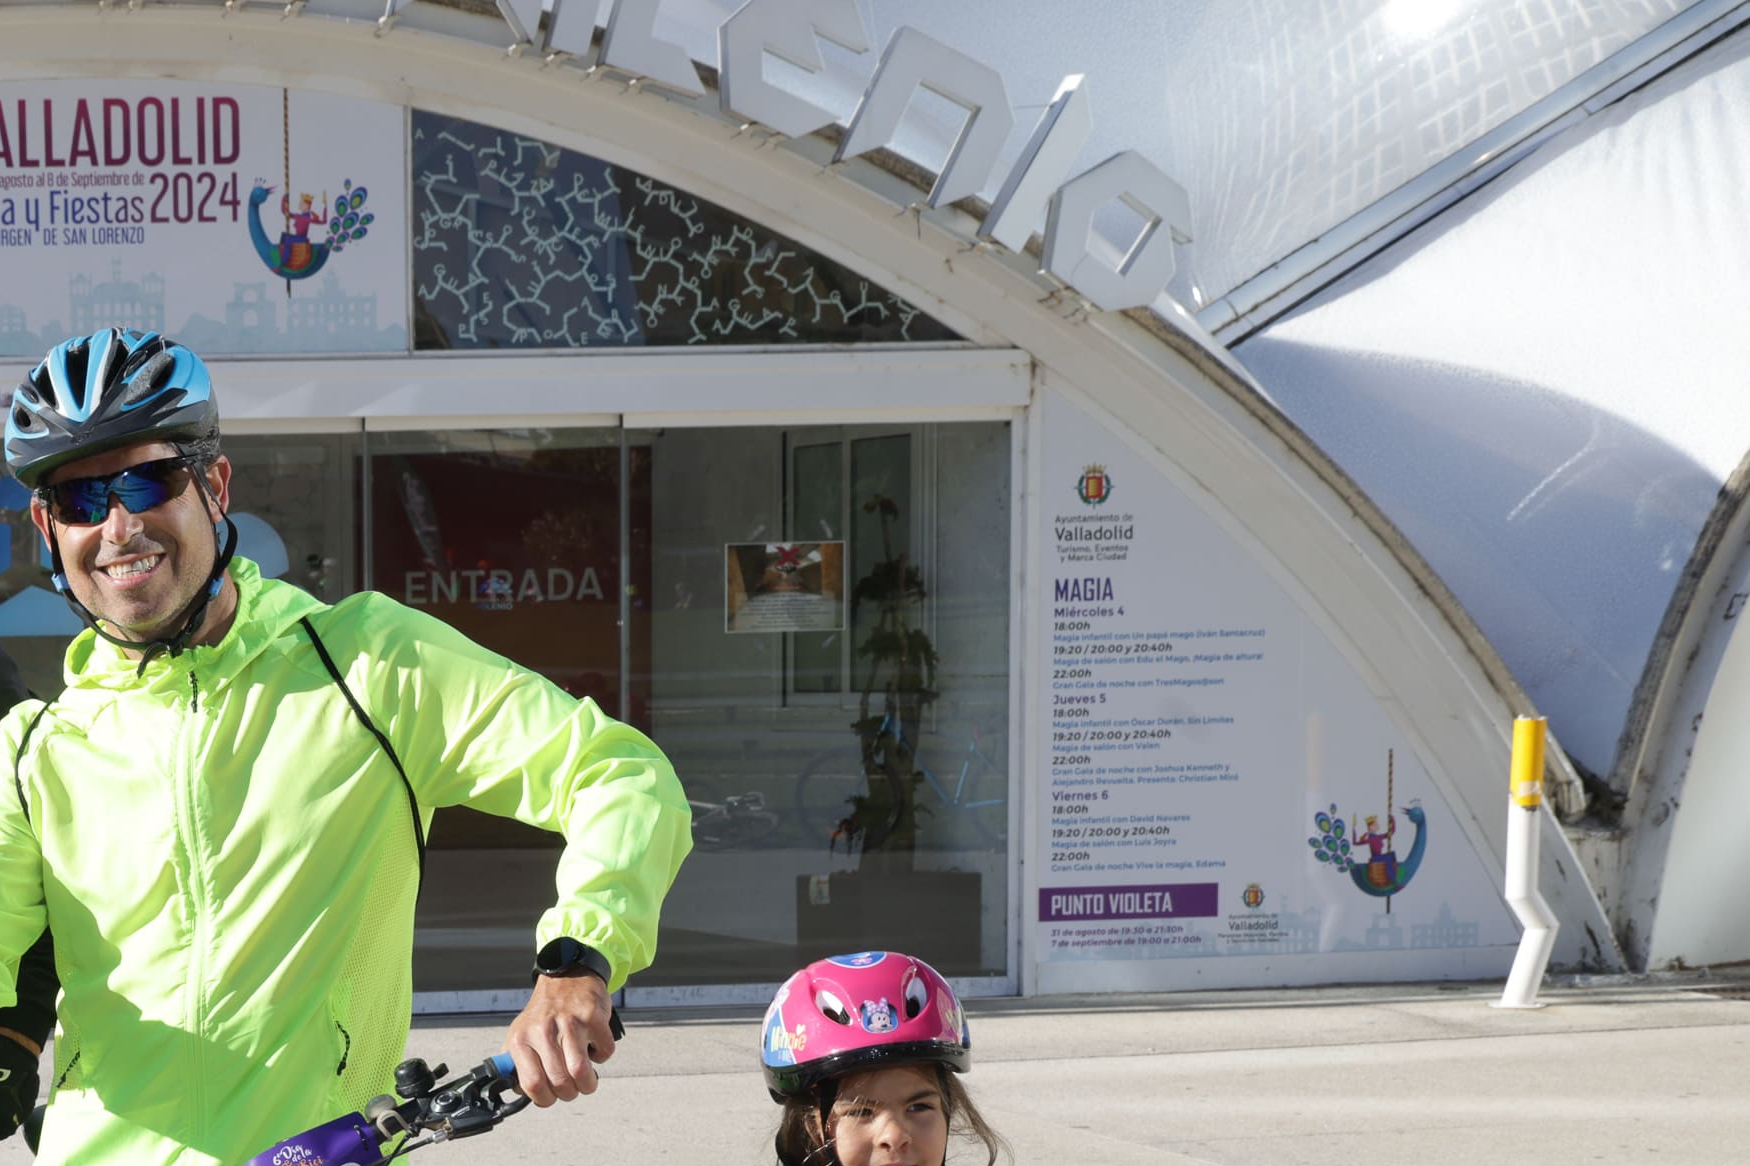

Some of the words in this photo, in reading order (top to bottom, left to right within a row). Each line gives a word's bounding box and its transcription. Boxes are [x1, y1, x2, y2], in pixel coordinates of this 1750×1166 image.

[0, 175, 34, 190] agosto
[36, 173, 45, 187] al
[47, 173, 54, 187] 8
[57, 172, 69, 187] de
[71, 171, 125, 189] Septiembre
[128, 171, 145, 186] de
[150, 171, 241, 224] 2024
[25, 198, 40, 232] y
[50, 190, 145, 225] Fiestas
[43, 228, 58, 246] DE
[63, 228, 87, 245] SAN
[92, 227, 145, 244] LORENZO
[1055, 524, 1134, 541] Valladolid
[405, 566, 604, 605] ENTRADA
[1054, 577, 1114, 602] MAGIA
[1054, 606, 1114, 618] Miércoles
[1117, 605, 1125, 616] 4
[1054, 621, 1091, 631] 18:00h
[1053, 669, 1092, 679] 22:00h
[1053, 695, 1096, 705] Jueves
[1099, 693, 1107, 703] 5
[1053, 708, 1090, 718] 18:00h
[1052, 755, 1091, 765] 22:00h
[1052, 791, 1098, 802] Viernes
[1101, 789, 1109, 800] 6
[1052, 804, 1089, 815] 18:00h
[1051, 851, 1090, 861] 22:00h
[1051, 894, 1104, 916] PUNTO
[1109, 892, 1173, 914] VIOLETA
[1229, 920, 1279, 931] Valladolid
